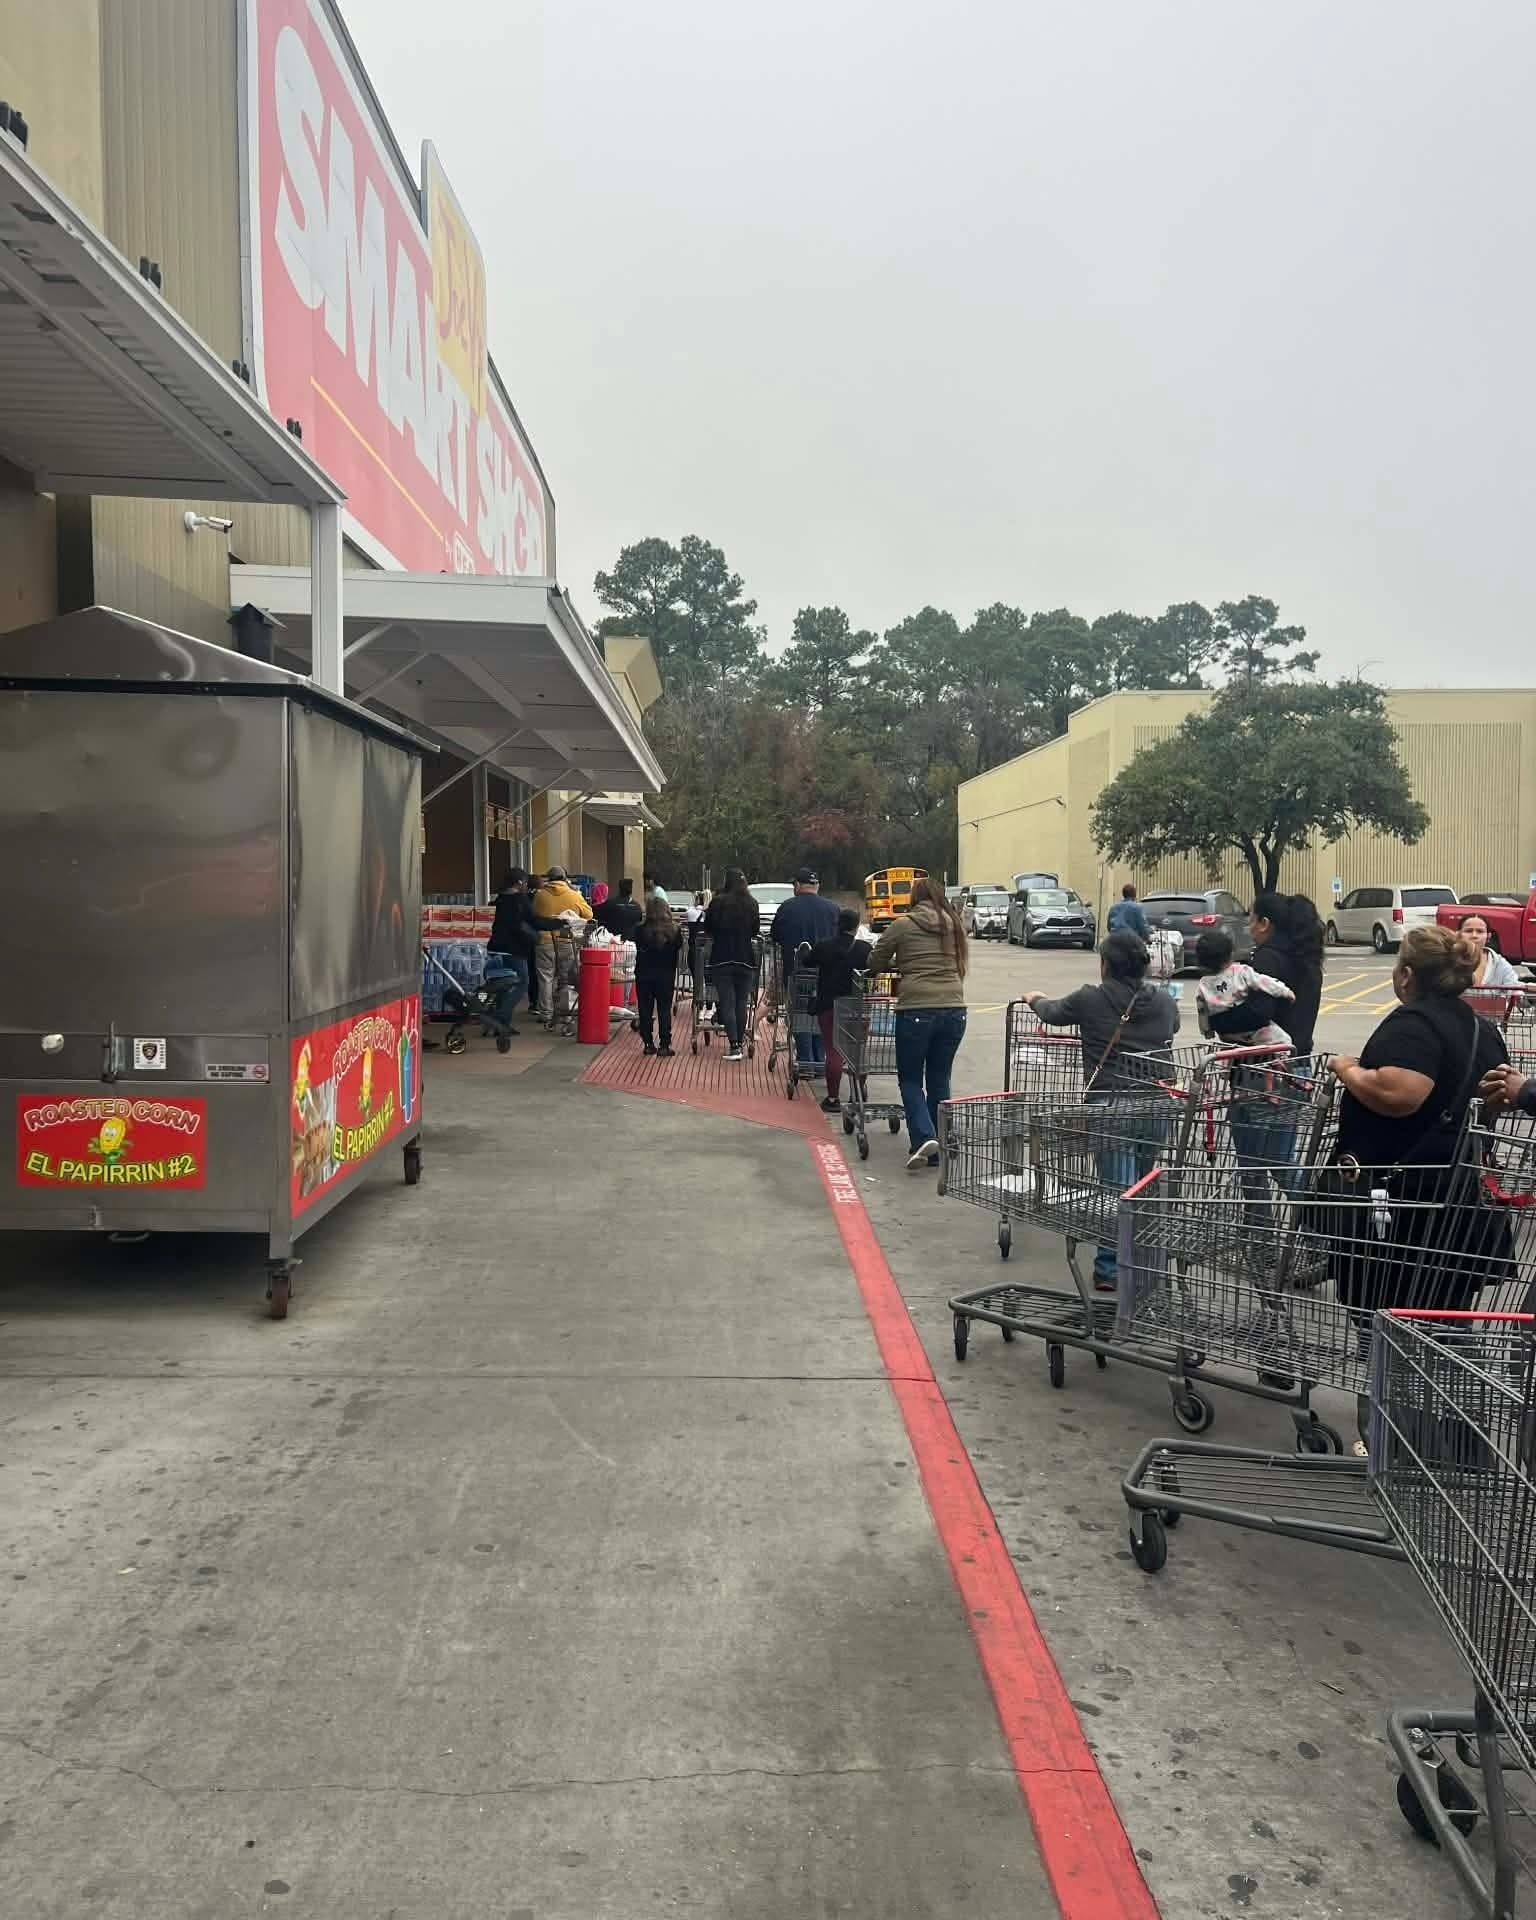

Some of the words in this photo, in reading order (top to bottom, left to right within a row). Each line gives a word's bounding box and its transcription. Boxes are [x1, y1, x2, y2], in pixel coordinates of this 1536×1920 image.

[274, 25, 472, 527] SMART
[333, 1016, 375, 1088] ROASTED
[374, 1016, 396, 1058] CORN
[24, 1099, 132, 1132] ROASTED
[132, 1101, 200, 1134] CORN
[333, 1122, 346, 1162] EL
[345, 1117, 385, 1162] PAPIRRIN
[26, 1151, 55, 1177] EL
[58, 1160, 165, 1184] PAPIRRIN
[166, 1154, 197, 1178] #2
